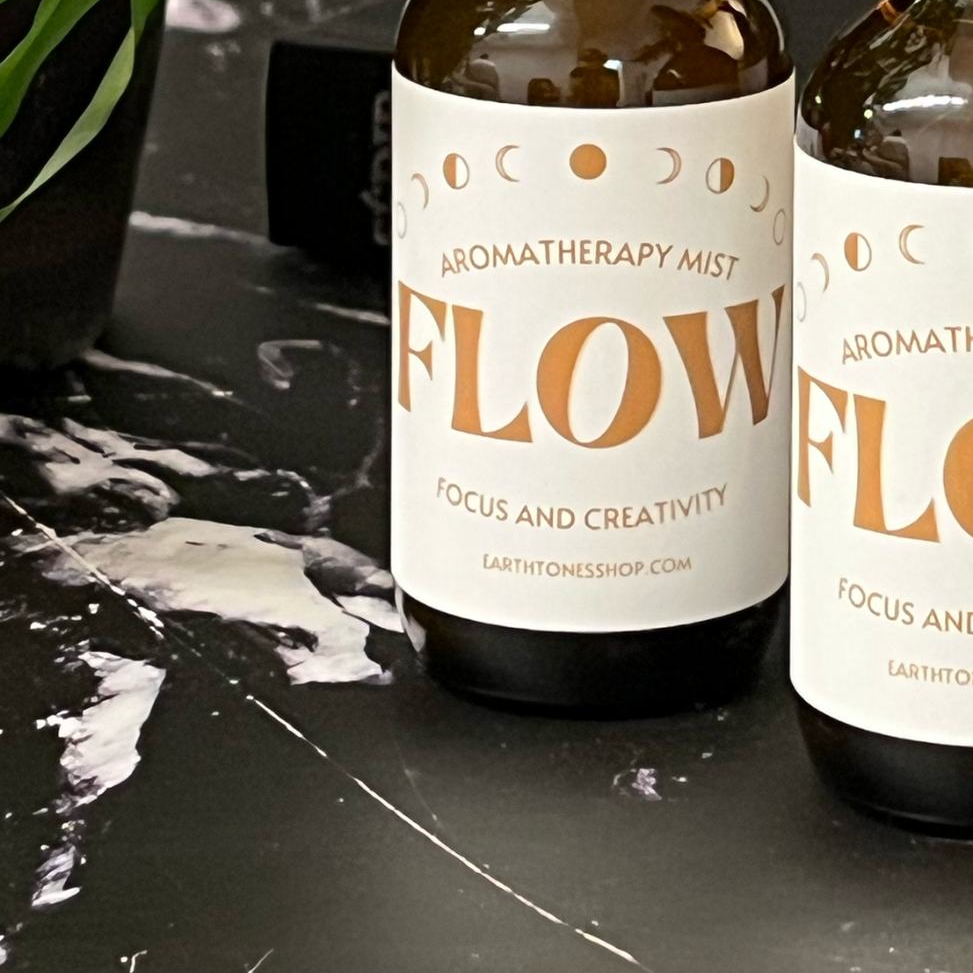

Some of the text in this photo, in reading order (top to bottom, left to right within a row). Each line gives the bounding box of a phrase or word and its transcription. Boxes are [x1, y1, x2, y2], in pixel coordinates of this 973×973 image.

[440, 238, 741, 280] AROMATHERAPY MIST
[398, 279, 786, 450] FLOW
[436, 476, 729, 531] FOCUS AND CREATIVITY
[482, 552, 693, 580] EARTHTONESSHOP.COM
[837, 577, 915, 627] FOCUS
